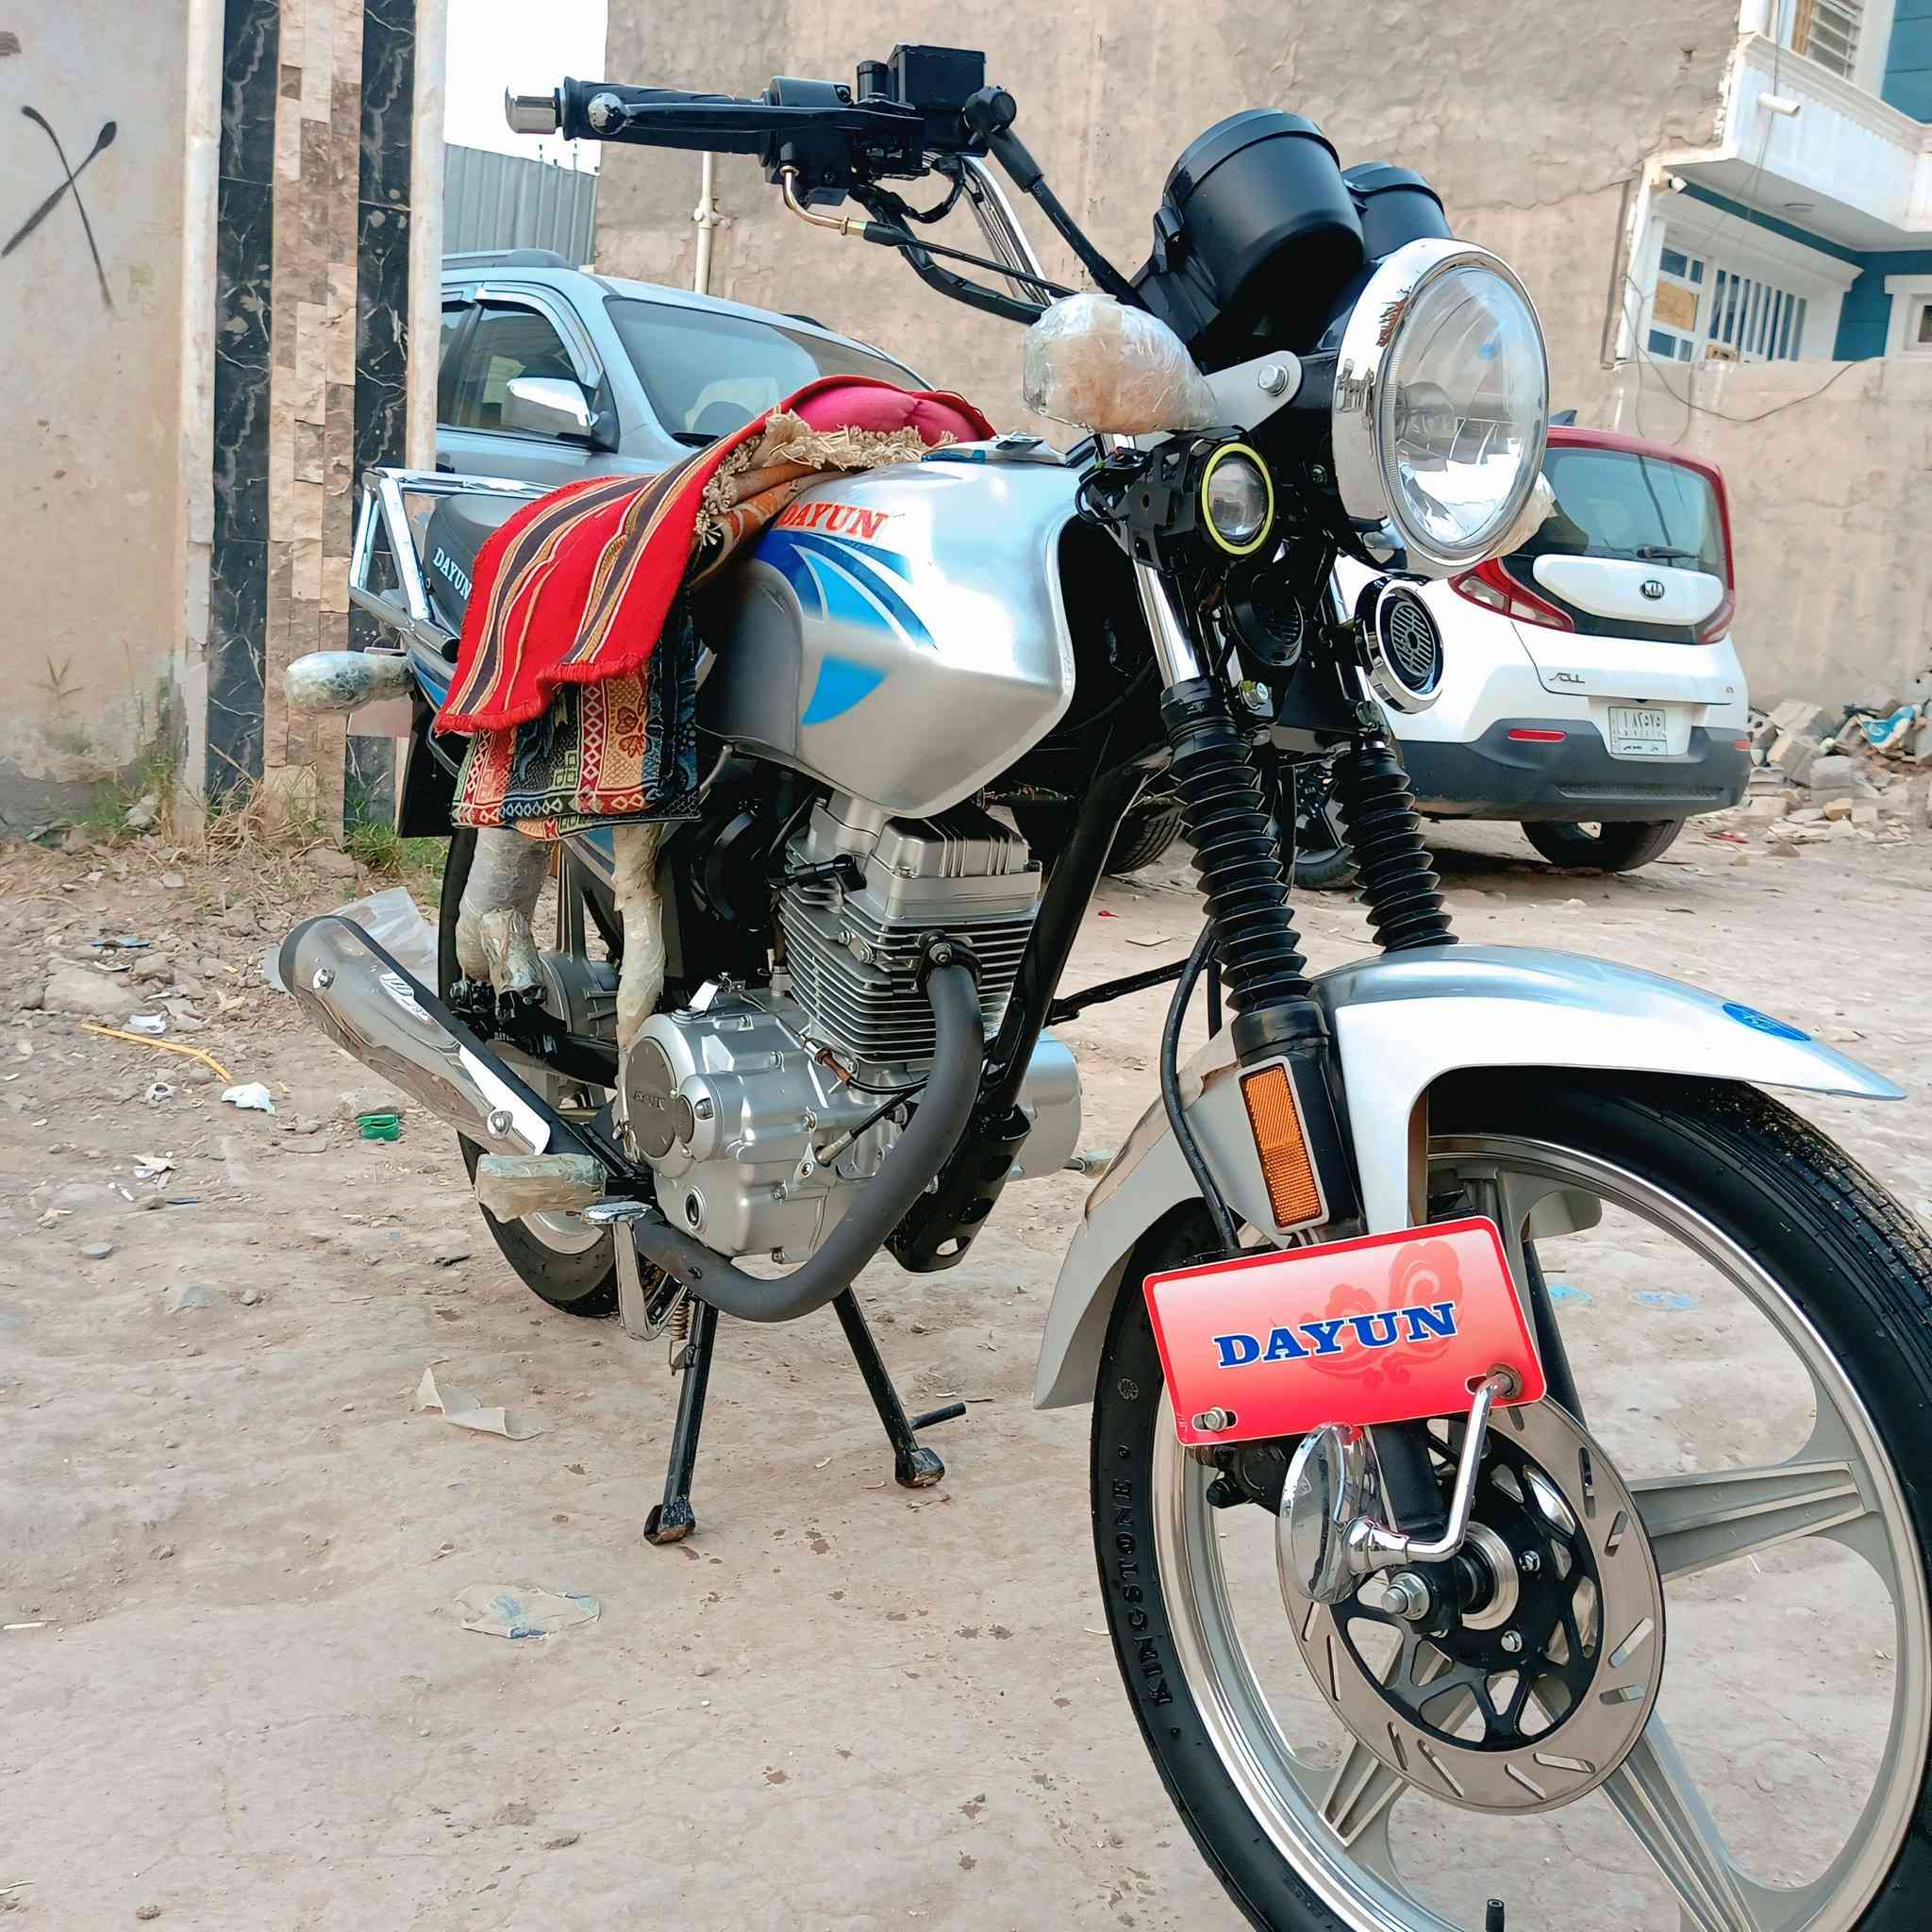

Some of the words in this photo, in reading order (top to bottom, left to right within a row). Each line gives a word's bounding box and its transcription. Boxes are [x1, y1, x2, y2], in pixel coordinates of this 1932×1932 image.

[777, 501, 890, 540] DAYUN
[433, 547, 473, 600] DAYUN
[1214, 1301, 1458, 1368] DAYUN
